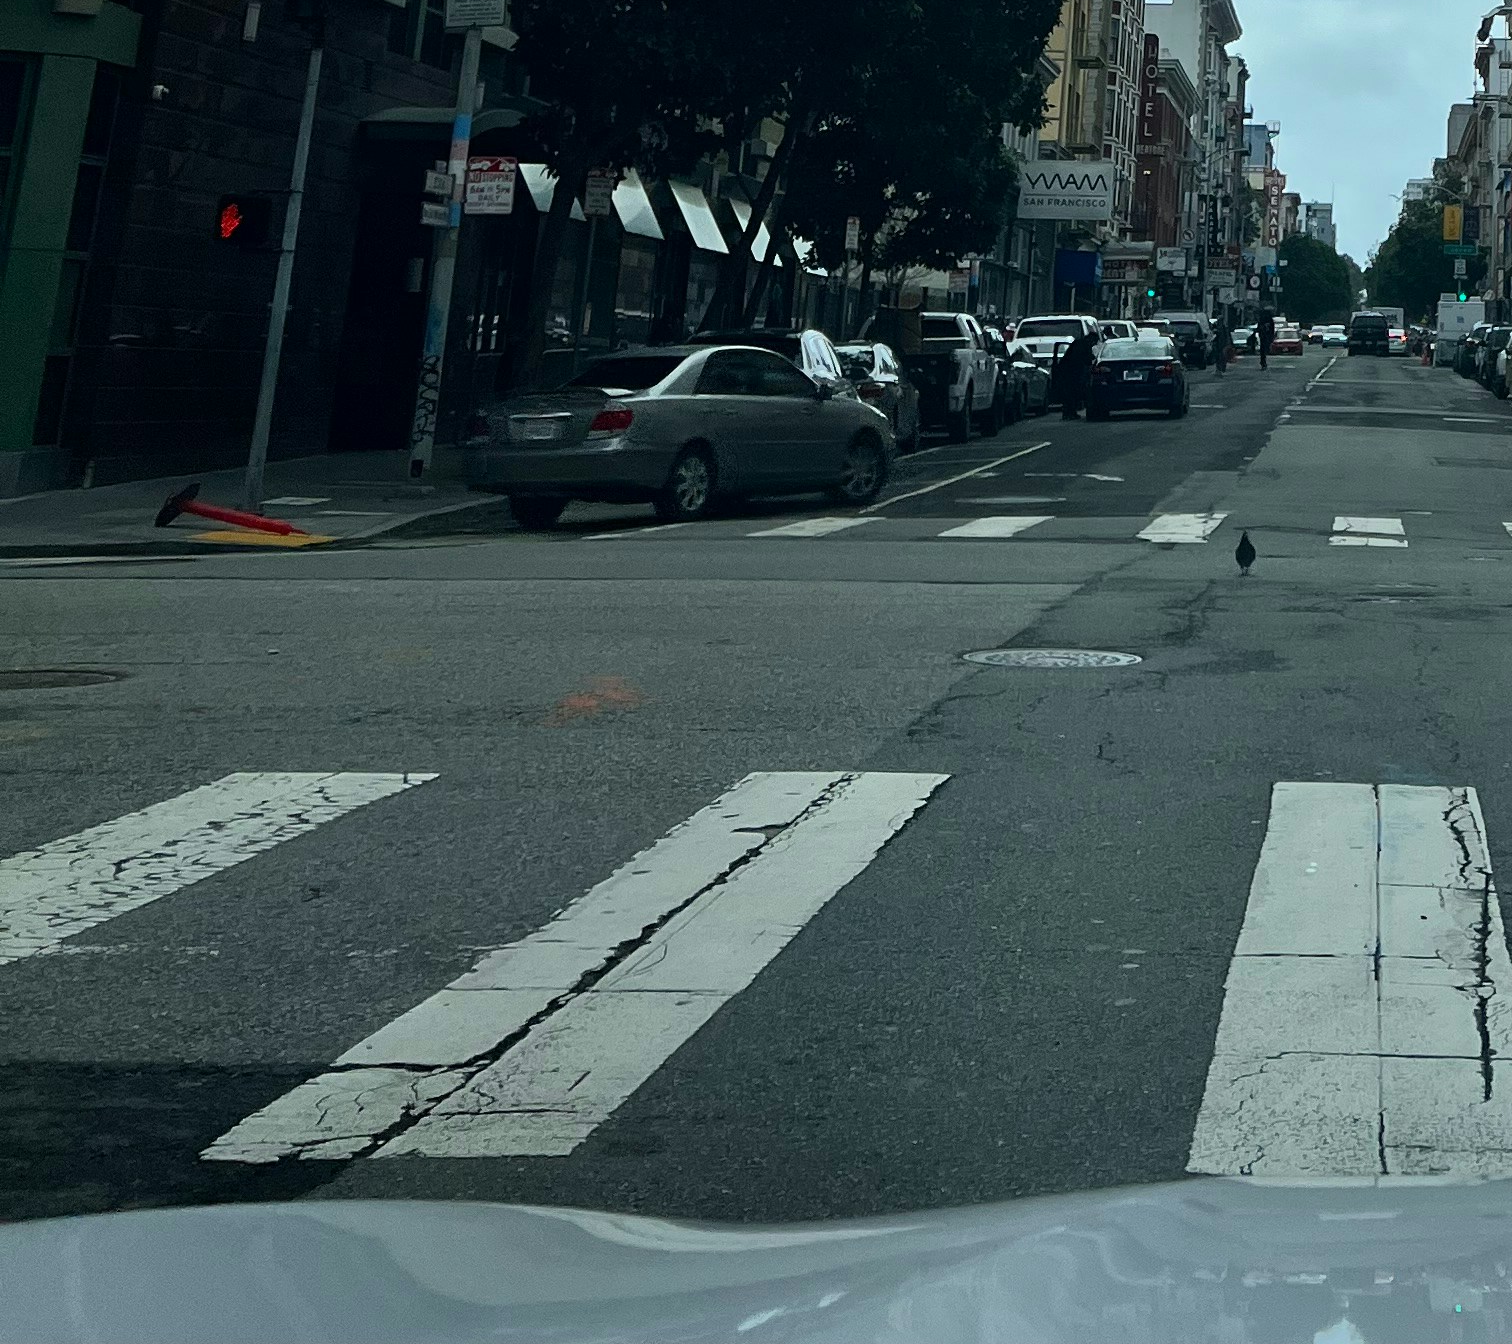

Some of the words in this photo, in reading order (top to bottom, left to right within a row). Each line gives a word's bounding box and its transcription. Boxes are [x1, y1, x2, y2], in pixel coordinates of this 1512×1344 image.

[1143, 44, 1158, 137] HOTEL
[1023, 198, 1044, 206] SAN
[1047, 199, 1106, 208] FRANCISCO
[1268, 186, 1279, 246] SENATO
